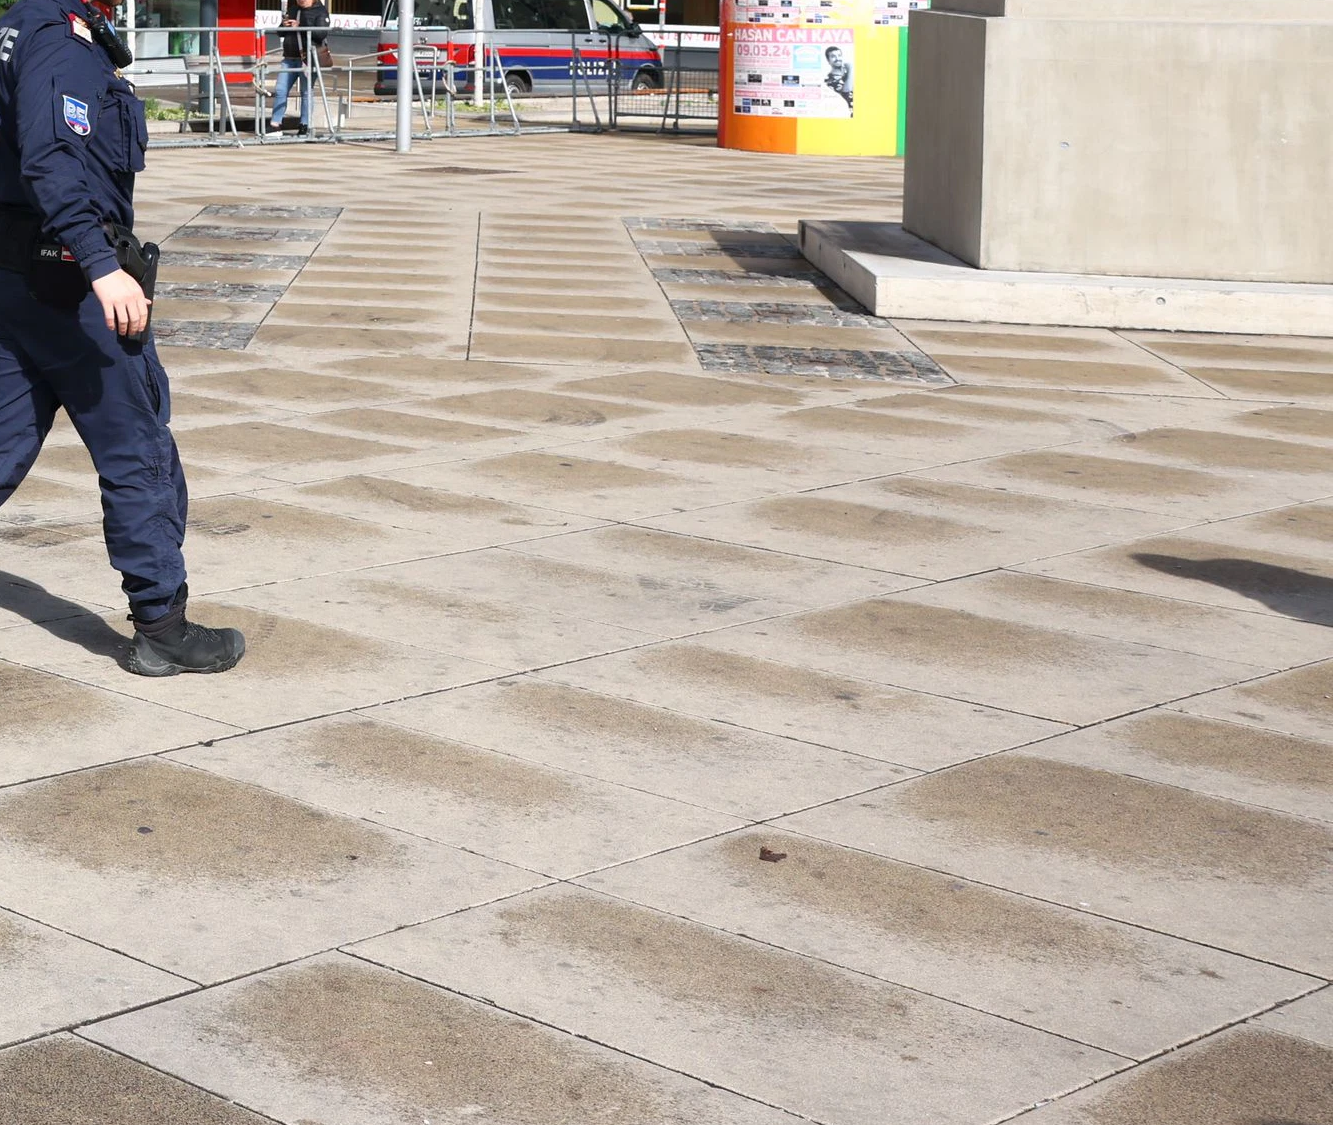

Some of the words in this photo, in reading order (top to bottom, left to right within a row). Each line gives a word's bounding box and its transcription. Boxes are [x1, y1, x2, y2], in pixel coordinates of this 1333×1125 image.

[735, 29, 773, 42] HASAN
[776, 29, 808, 42] CAN
[812, 29, 852, 43] KAYA
[737, 44, 791, 56] 09.03.24
[66, 101, 87, 120] BE
[40, 249, 58, 257] IFAK
